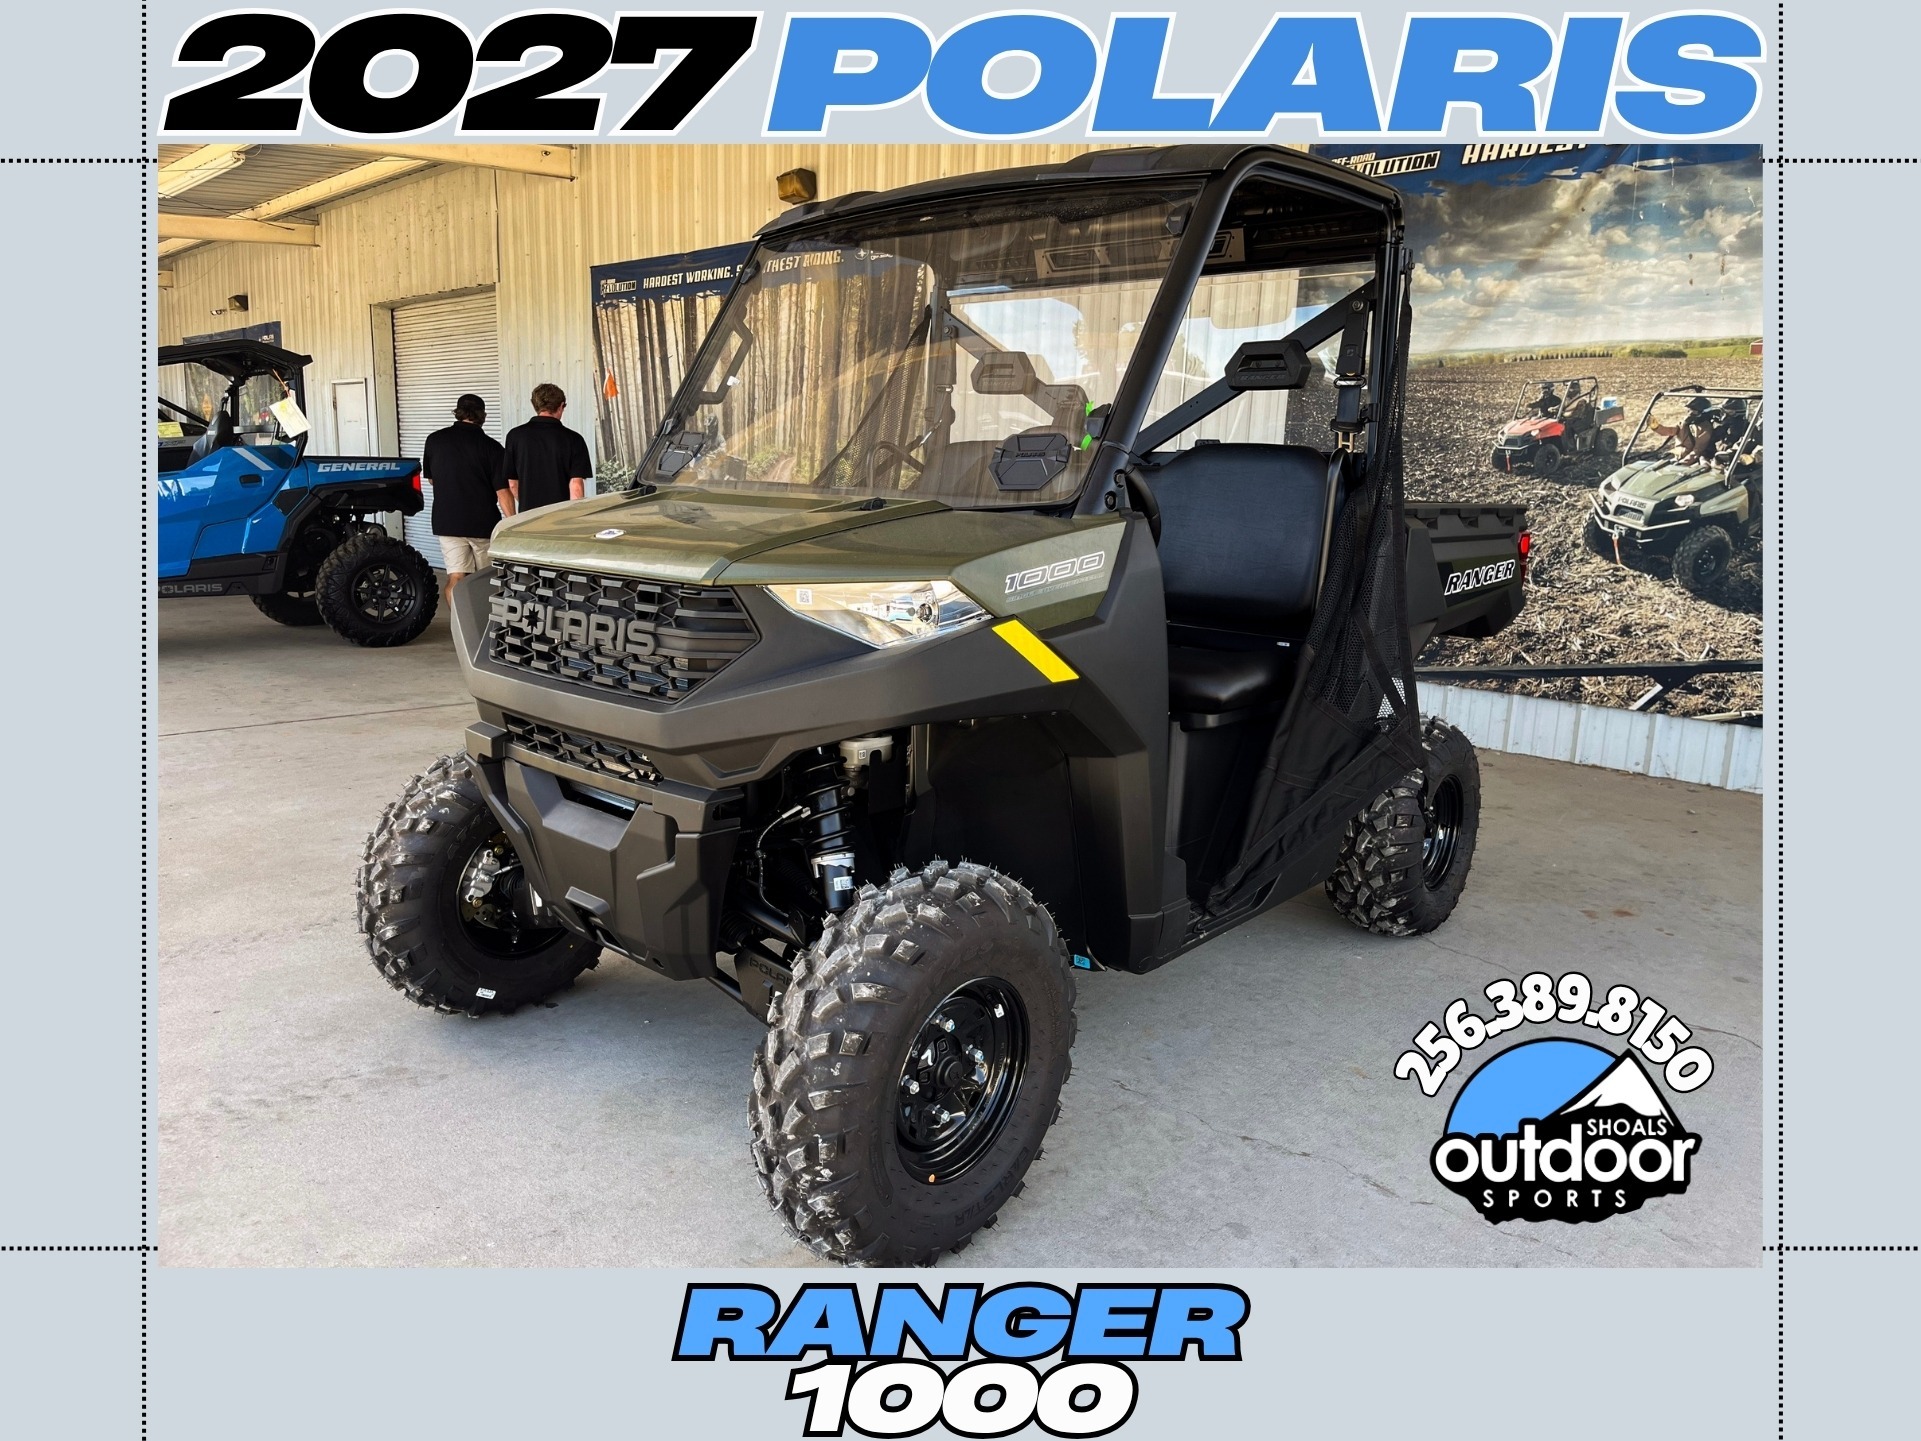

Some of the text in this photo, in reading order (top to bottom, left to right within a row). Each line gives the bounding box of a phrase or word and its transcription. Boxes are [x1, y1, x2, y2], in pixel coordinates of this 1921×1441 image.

[1347, 150, 1441, 177] VOLUTION
[1461, 143, 1587, 165] HARD
[642, 272, 684, 290] HARDEST
[686, 265, 734, 284] WORKING.
[316, 462, 401, 473] GENERAL
[1004, 550, 1106, 594] 1000
[1444, 558, 1517, 596] RANGER
[499, 597, 656, 656] POLARIS
[749, 956, 793, 986] POLAR
